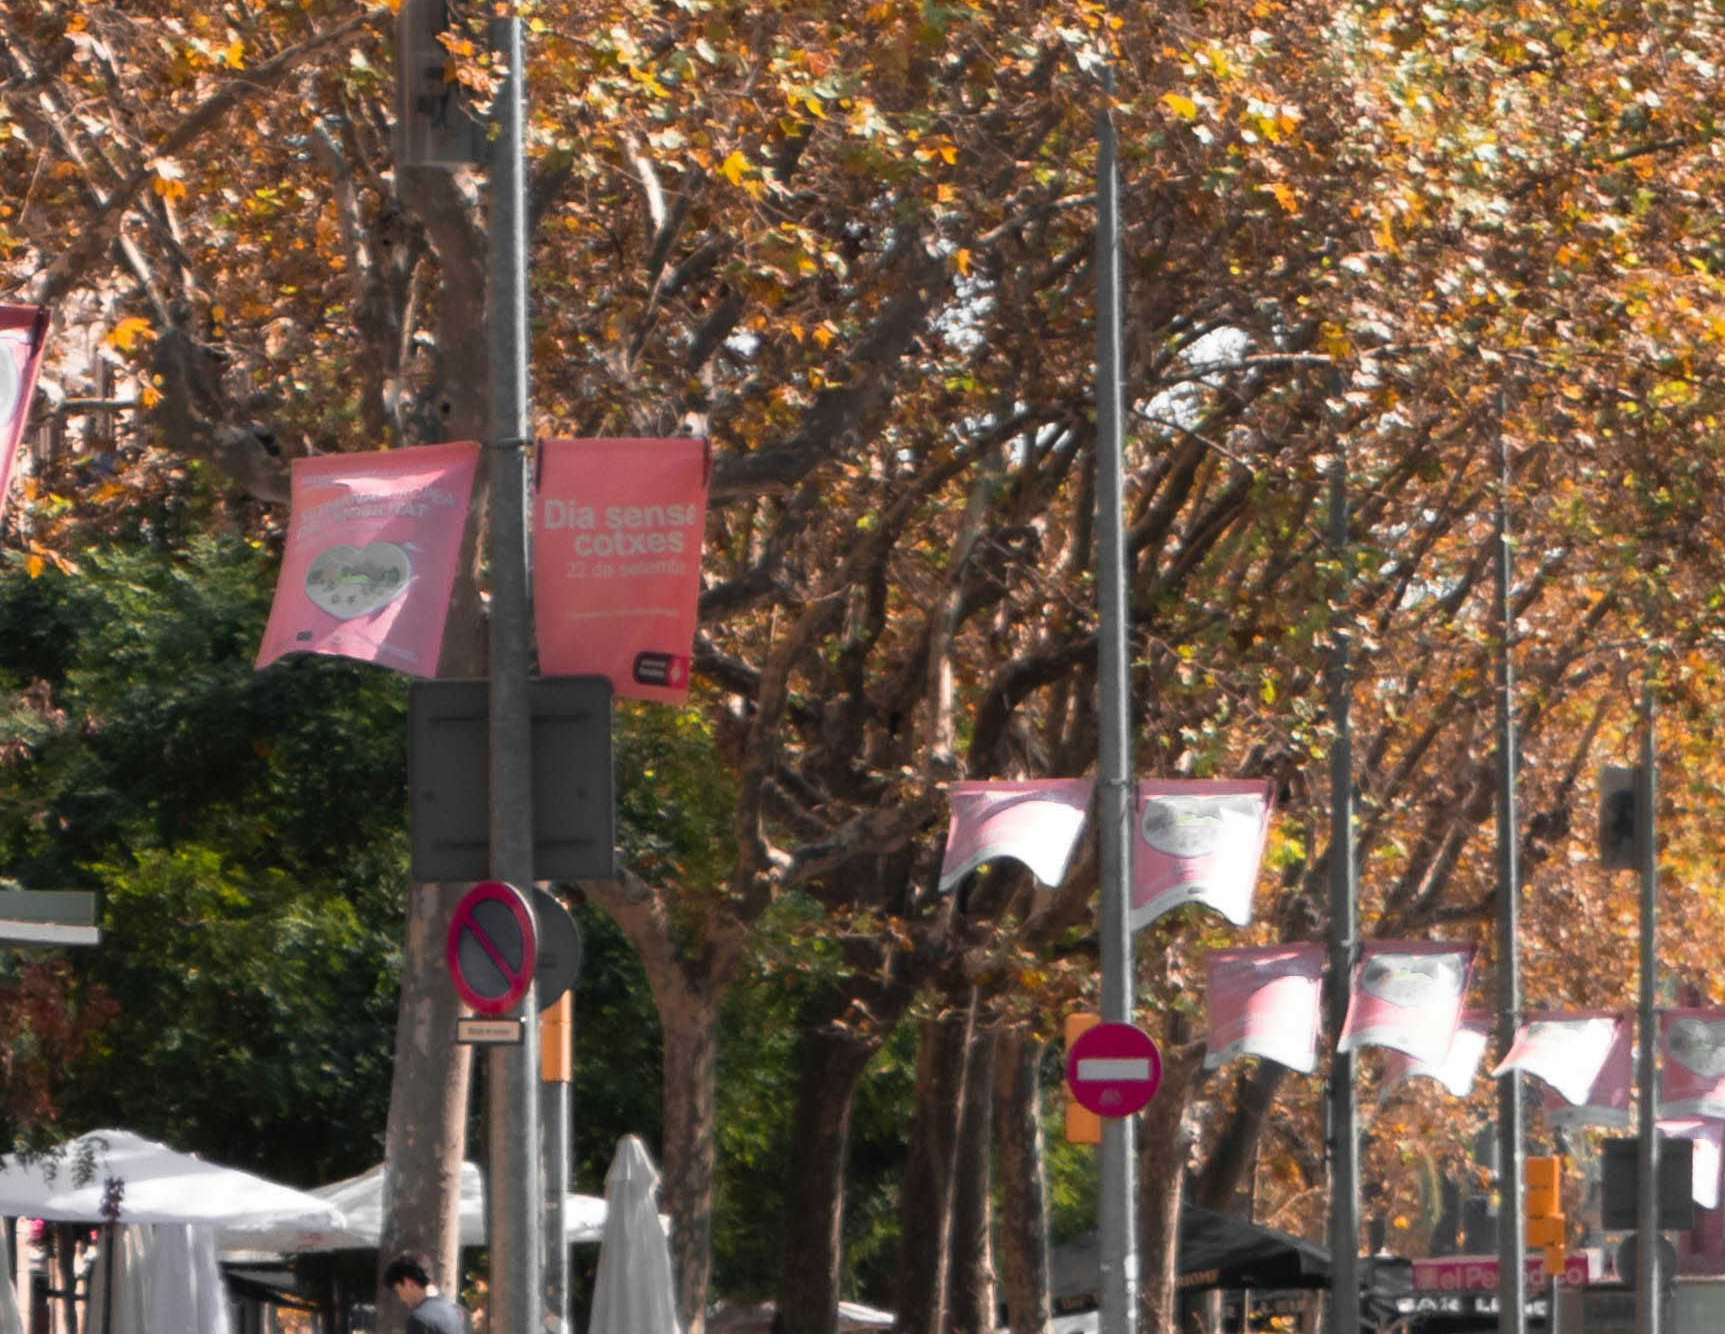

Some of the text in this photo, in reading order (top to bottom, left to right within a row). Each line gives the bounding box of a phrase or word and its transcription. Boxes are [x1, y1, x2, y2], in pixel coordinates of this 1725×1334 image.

[543, 499, 594, 530] Dia
[573, 530, 685, 557] cotxes
[566, 562, 587, 578] 22
[1440, 1266, 1462, 1290] el
